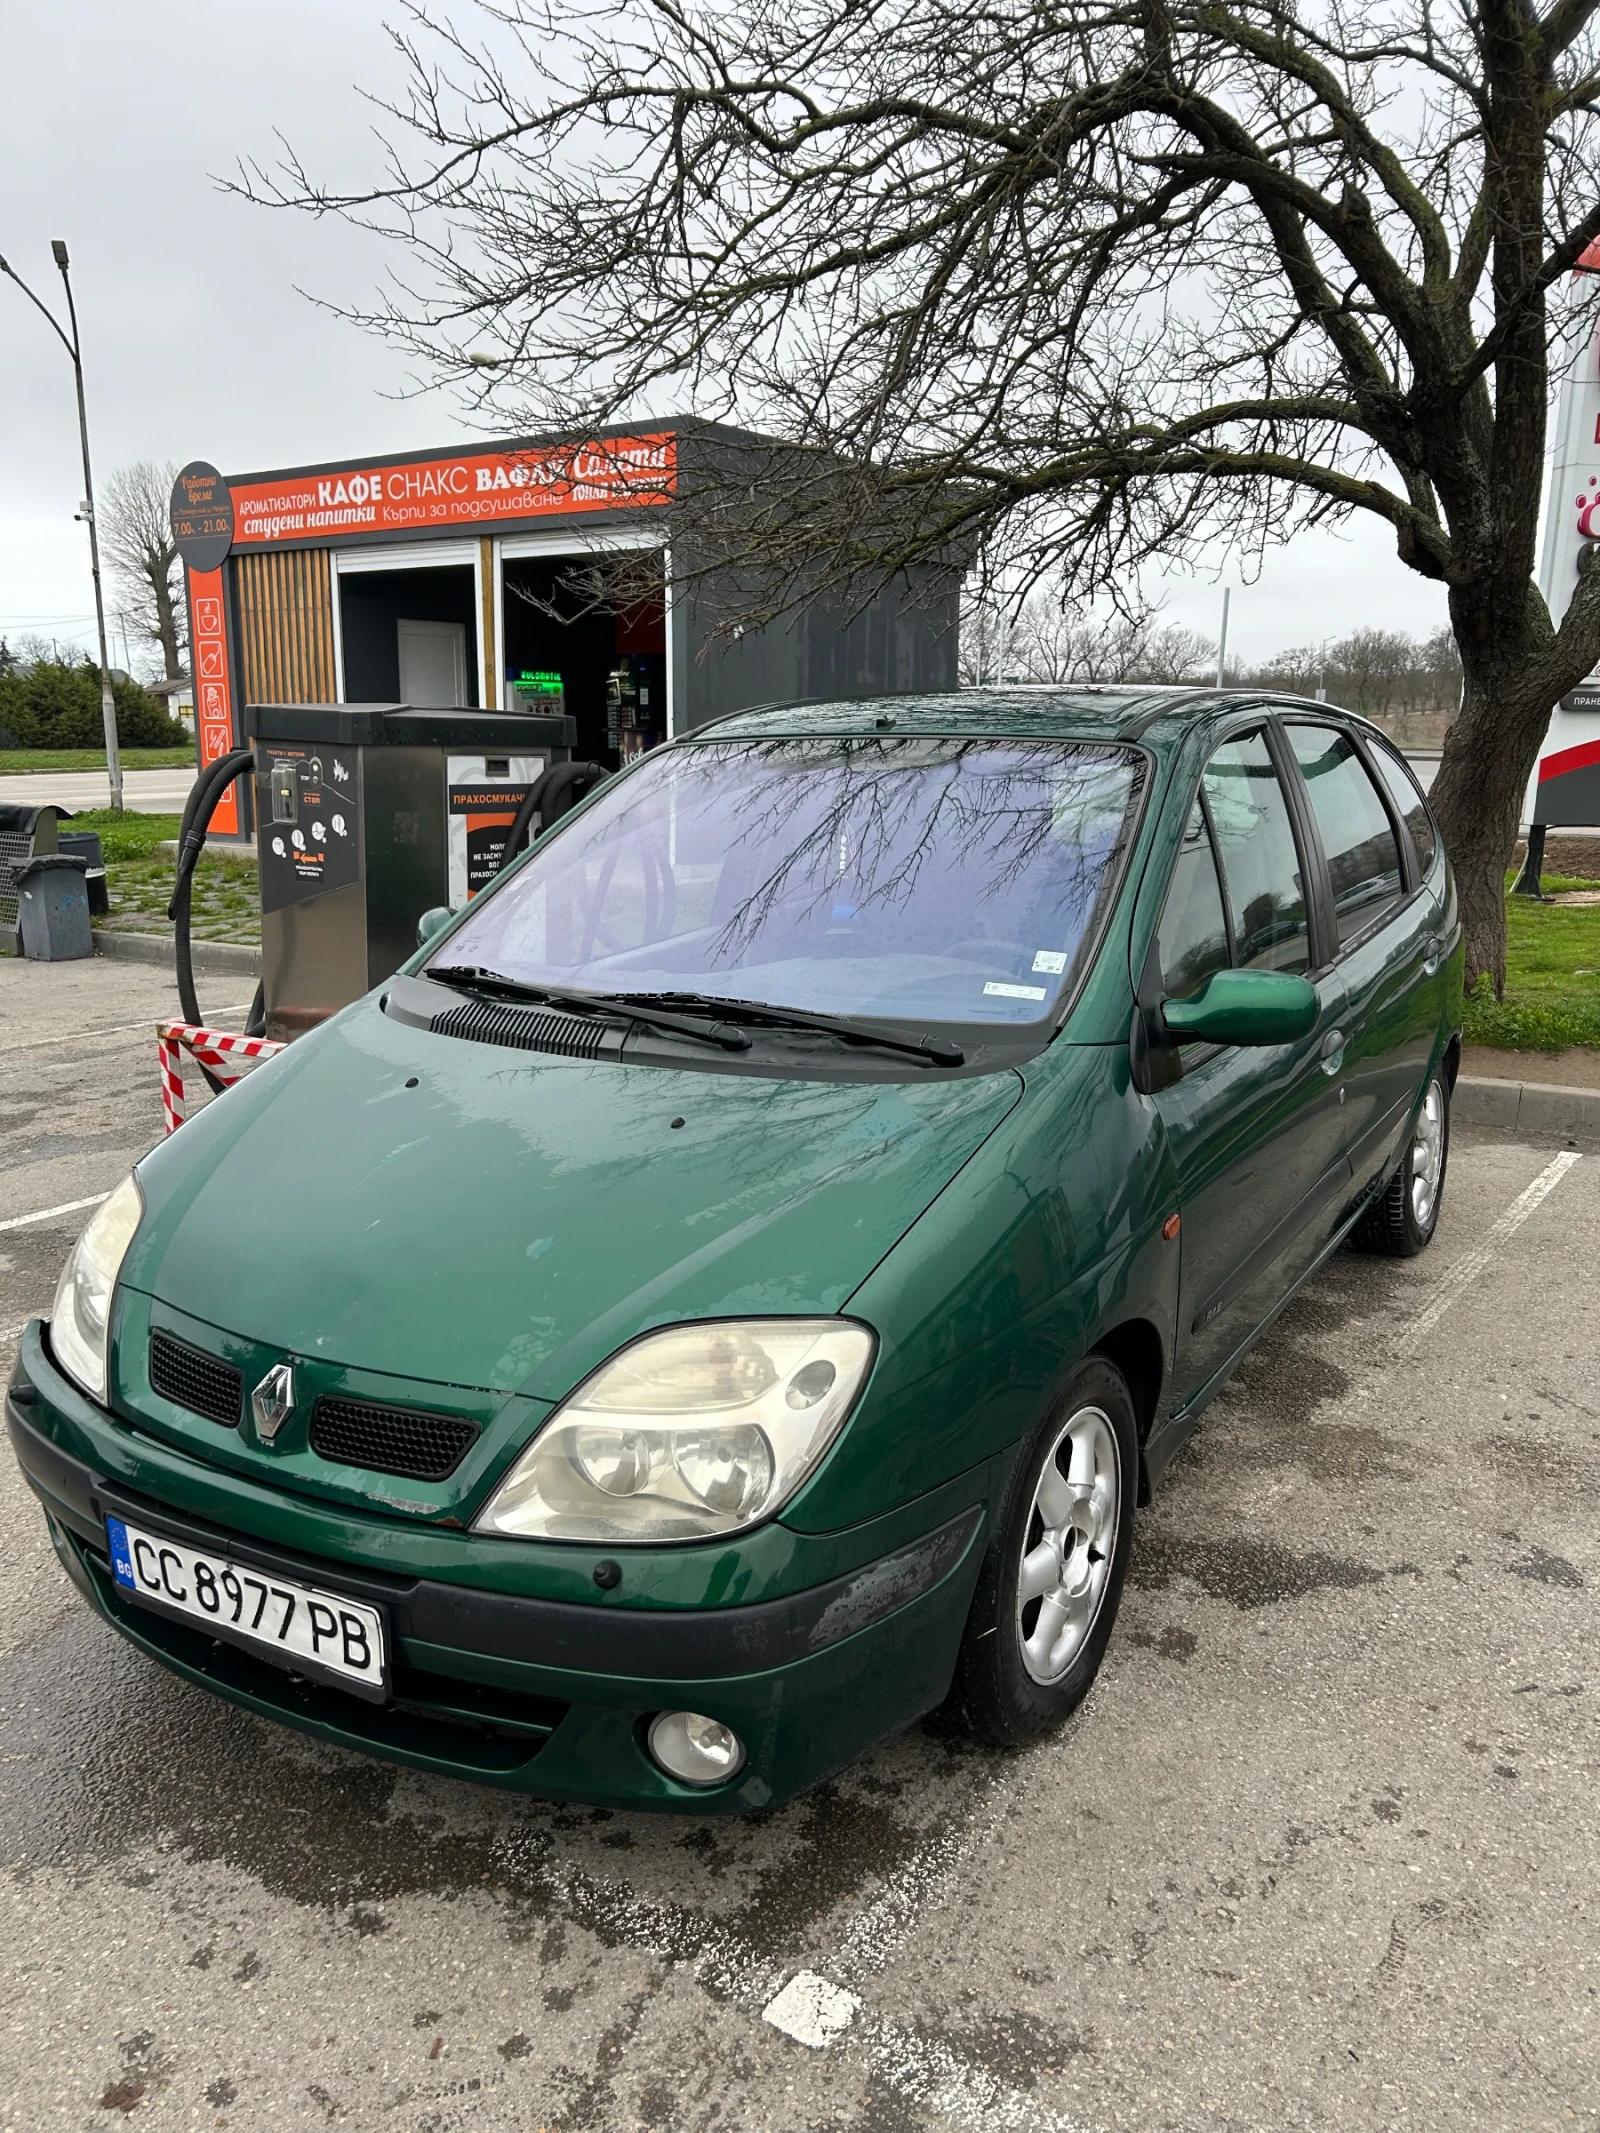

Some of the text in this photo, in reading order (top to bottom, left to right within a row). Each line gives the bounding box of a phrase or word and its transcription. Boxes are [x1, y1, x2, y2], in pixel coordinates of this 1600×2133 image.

[239, 493, 316, 516] АРОМАТИЗАТОРИ
[318, 474, 383, 506] КАФЕ
[387, 466, 469, 500] СНАКС
[382, 491, 564, 523] Кърпи за подсушаване
[244, 505, 376, 539] студени напитки
[303, 796, 321, 804] СТОП
[116, 1558, 132, 1578] BG
